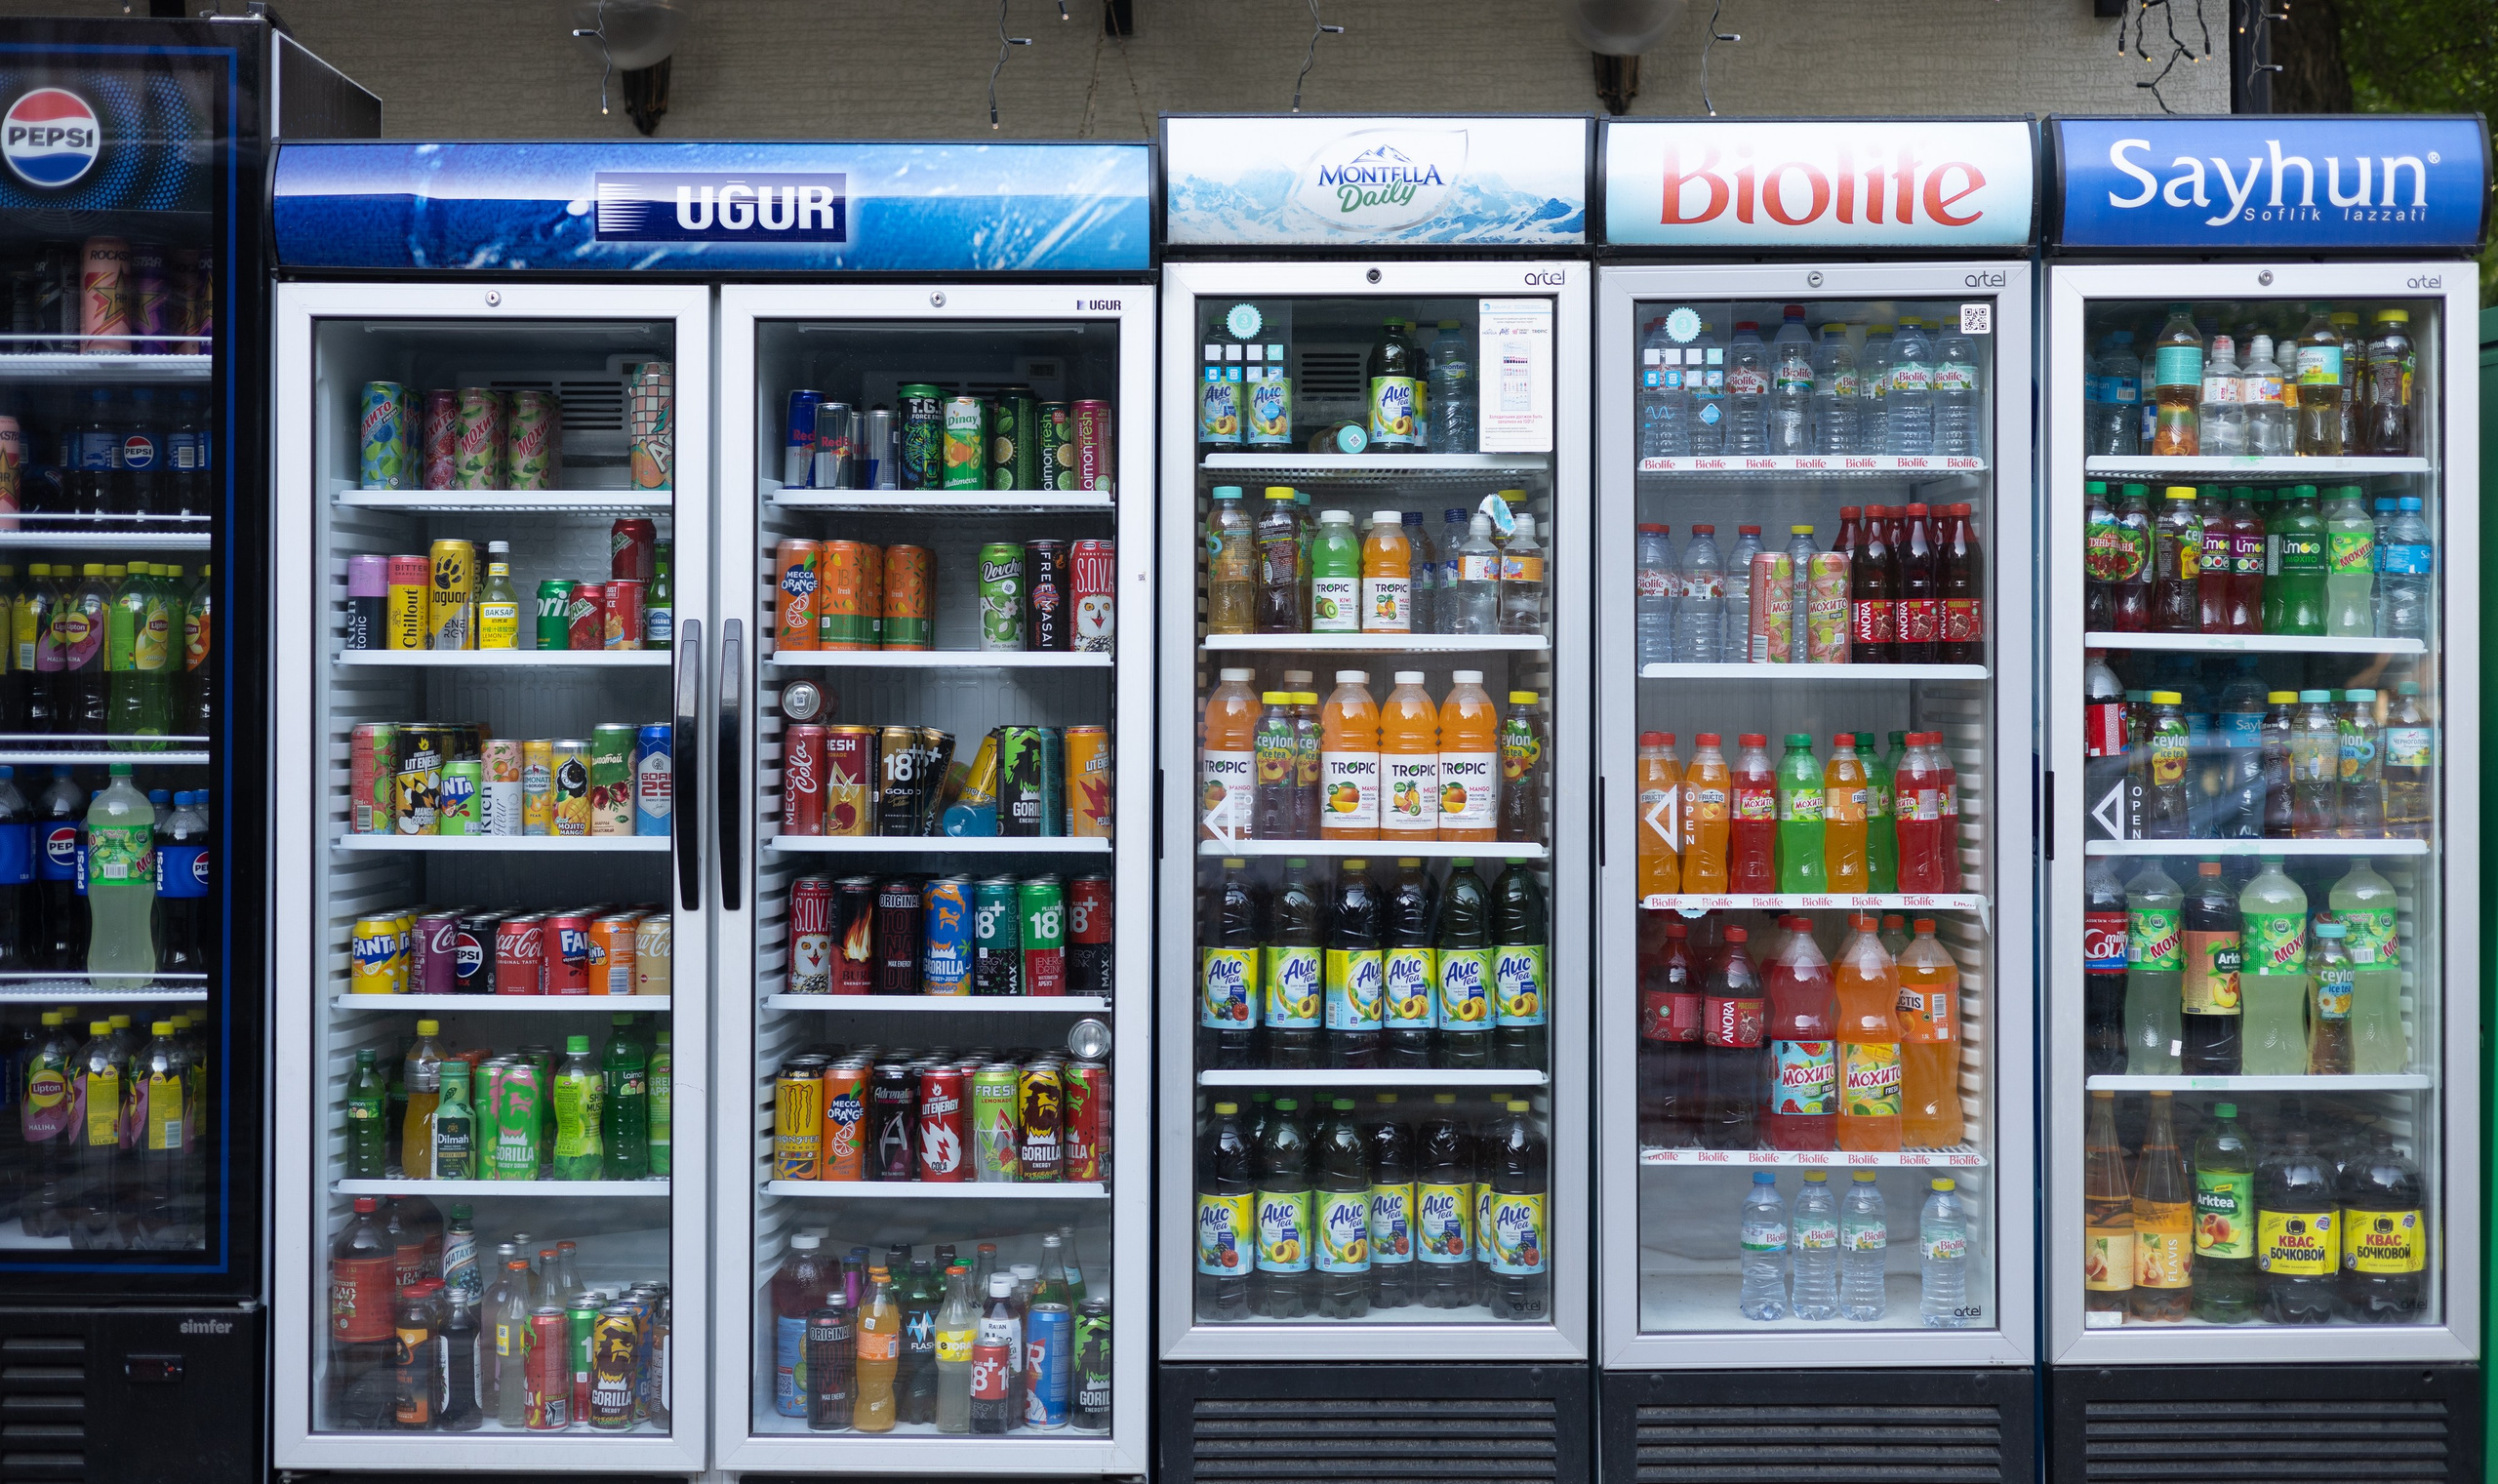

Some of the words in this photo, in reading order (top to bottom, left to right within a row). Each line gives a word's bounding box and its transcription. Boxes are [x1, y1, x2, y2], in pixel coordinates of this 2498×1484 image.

[8, 127, 94, 147] PEPSI
[1317, 165, 1446, 186] MONTELLA
[1660, 141, 1987, 225] Biolife
[1337, 178, 1418, 213] Daily
[2244, 208, 2320, 221] Soflik
[2345, 208, 2426, 221] lazzati
[90, 250, 130, 261] ROCKS
[1524, 268, 1565, 285] artel
[1964, 270, 2006, 288] artel
[2407, 275, 2441, 289] artel
[1730, 377, 1756, 386] Biolife
[1899, 372, 1927, 381] Biolife
[1935, 372, 1961, 381] Biolife
[1645, 460, 1675, 469] Biolife
[1695, 460, 1726, 469] Biolife
[1746, 460, 1777, 469] Biolife
[1795, 459, 1827, 469] Biolife
[1846, 459, 1876, 468] Biolife
[1898, 458, 1928, 467] Biolife
[1948, 459, 1978, 468] Biolife
[2340, 541, 2373, 567] МОХИТО
[982, 558, 1024, 582] Dovcha
[782, 579, 818, 592] ORANGE
[1316, 583, 1349, 592] TROPIC
[1375, 583, 1407, 592] TROPIC
[432, 589, 466, 607] Jaguar
[1809, 598, 1847, 614] МОХИТО
[403, 589, 419, 648] Chillout
[1862, 601, 1871, 639] ANORA
[827, 740, 856, 751] RESH
[1257, 734, 1293, 749] ceylon
[2154, 734, 2189, 748] ceylon
[2393, 738, 2431, 746] ЧЕРНОГОЛОВ
[795, 742, 817, 794] Cola
[1205, 760, 1247, 774] TROPIC
[1331, 761, 1375, 775] TROPIC
[1392, 764, 1435, 778] TROPIC
[1442, 761, 1486, 775] TROPIC
[785, 767, 795, 825] MECCA
[1698, 793, 1724, 802] FRUCTIS
[1742, 797, 1774, 809] МОХИТО
[1686, 791, 1695, 845] OPEN
[2132, 786, 2141, 840] OPEN
[879, 895, 919, 907] ORIGINAL
[1652, 898, 1682, 907] Biolife
[1702, 898, 1733, 907] Biolife
[1753, 898, 1783, 907] Biolife
[1802, 897, 1833, 907] Biolife
[1852, 897, 1882, 906] Biolife
[1904, 896, 1934, 906] Biolife
[352, 935, 396, 957] FANTA
[929, 961, 964, 975] GORILLA
[1225, 974, 1241, 984] Tea
[1404, 974, 1421, 983] Tea
[1462, 976, 1478, 985] Tea
[1513, 973, 1530, 983] Tea
[1722, 1001, 1735, 1043] ANORA
[32, 1084, 60, 1095] Lipton
[976, 1086, 1017, 1097] FRESH
[1884, 1084, 1900, 1096] FRESH
[827, 1108, 864, 1120] ORANGE
[438, 1134, 469, 1143] Dilmah
[777, 1135, 820, 1143] MONSTER
[497, 1146, 534, 1162] GORILLA
[1022, 1146, 1062, 1161] GORILLA
[1699, 1152, 1729, 1162] Biolife
[1749, 1152, 1779, 1163] Biolife
[1798, 1153, 1829, 1164] Biolife
[1848, 1154, 1878, 1165] Biolife
[1900, 1154, 1930, 1165] Biolife
[1950, 1155, 1979, 1166] Biolife
[931, 1162, 947, 1171] COLA
[2197, 1193, 2235, 1208] Arktea
[1387, 1209, 1402, 1219] Tea
[1437, 1209, 1453, 1219] Tea
[1213, 1220, 1229, 1229] Tea
[1275, 1218, 1293, 1227] Tea
[1348, 1219, 1363, 1228] Tea
[1513, 1220, 1529, 1229] Tea
[1811, 1229, 1836, 1240] Biolife
[2366, 1234, 2401, 1246] КВАС
[1941, 1239, 1964, 1251] Biolife
[2278, 1235, 2315, 1248] КВАС
[2271, 1246, 2324, 1261] БОЧКОВОЙ
[2357, 1244, 2411, 1259] БОЧКОВОЙ
[2168, 1239, 2178, 1282] FLAVIS
[1513, 1301, 1540, 1310] artel
[1954, 1304, 1981, 1316] artel
[2401, 1300, 2427, 1309] artel
[181, 1320, 232, 1334] simfer
[810, 1327, 851, 1341] ORIGINAL
[592, 1390, 631, 1406] GORILLA
